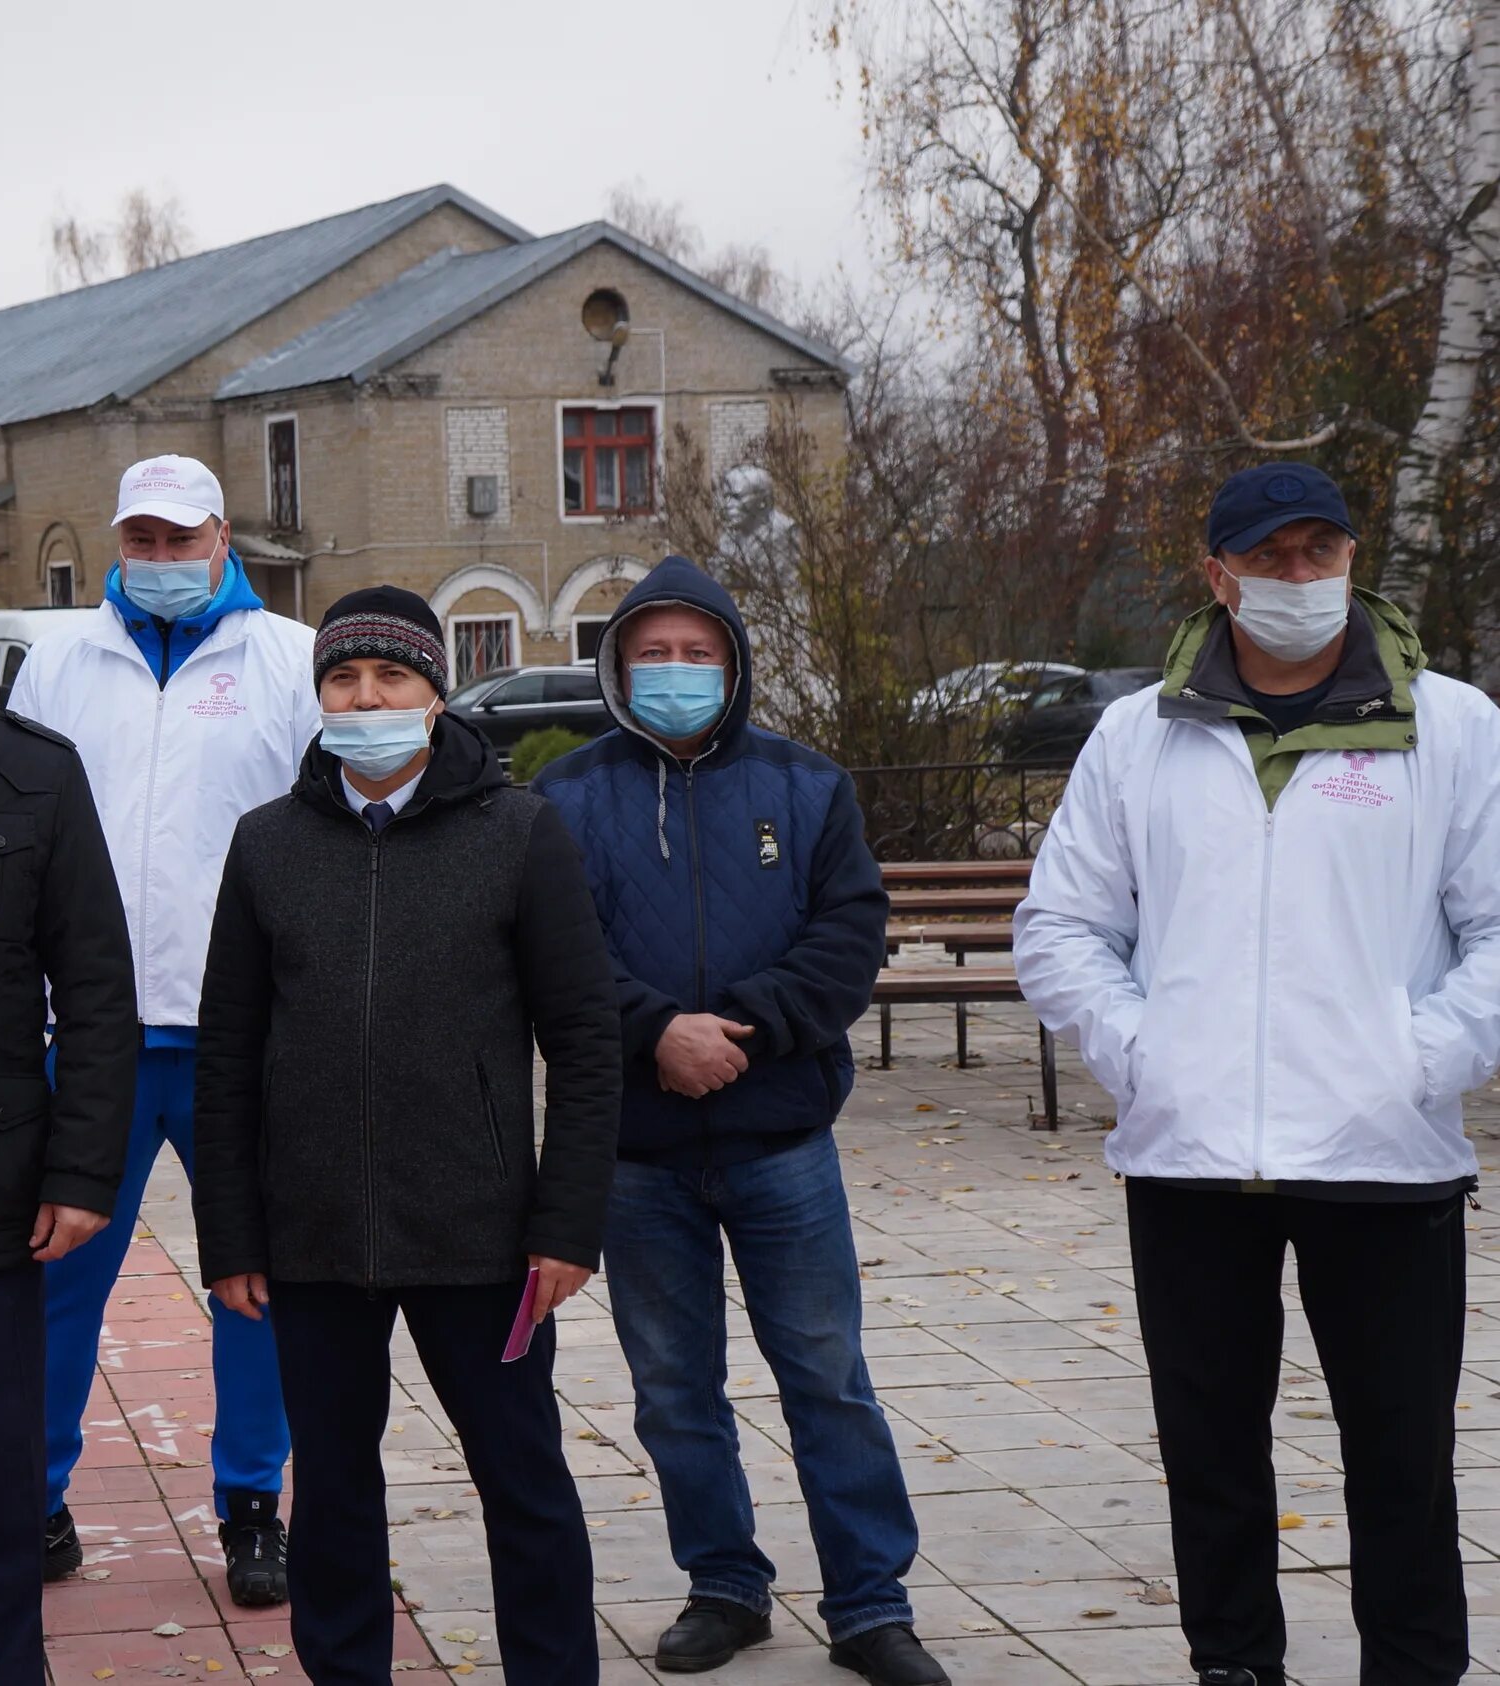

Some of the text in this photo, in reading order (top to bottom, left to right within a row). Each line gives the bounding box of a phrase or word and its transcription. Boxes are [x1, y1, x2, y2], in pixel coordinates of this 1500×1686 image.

[1327, 776, 1382, 791] АКТИВНЫХ
[1343, 771, 1368, 781] СЕТЬ
[1311, 783, 1394, 802] ФИЗКУЛЬТУРНЫХ
[1321, 790, 1383, 807] МАРШРУТОВ
